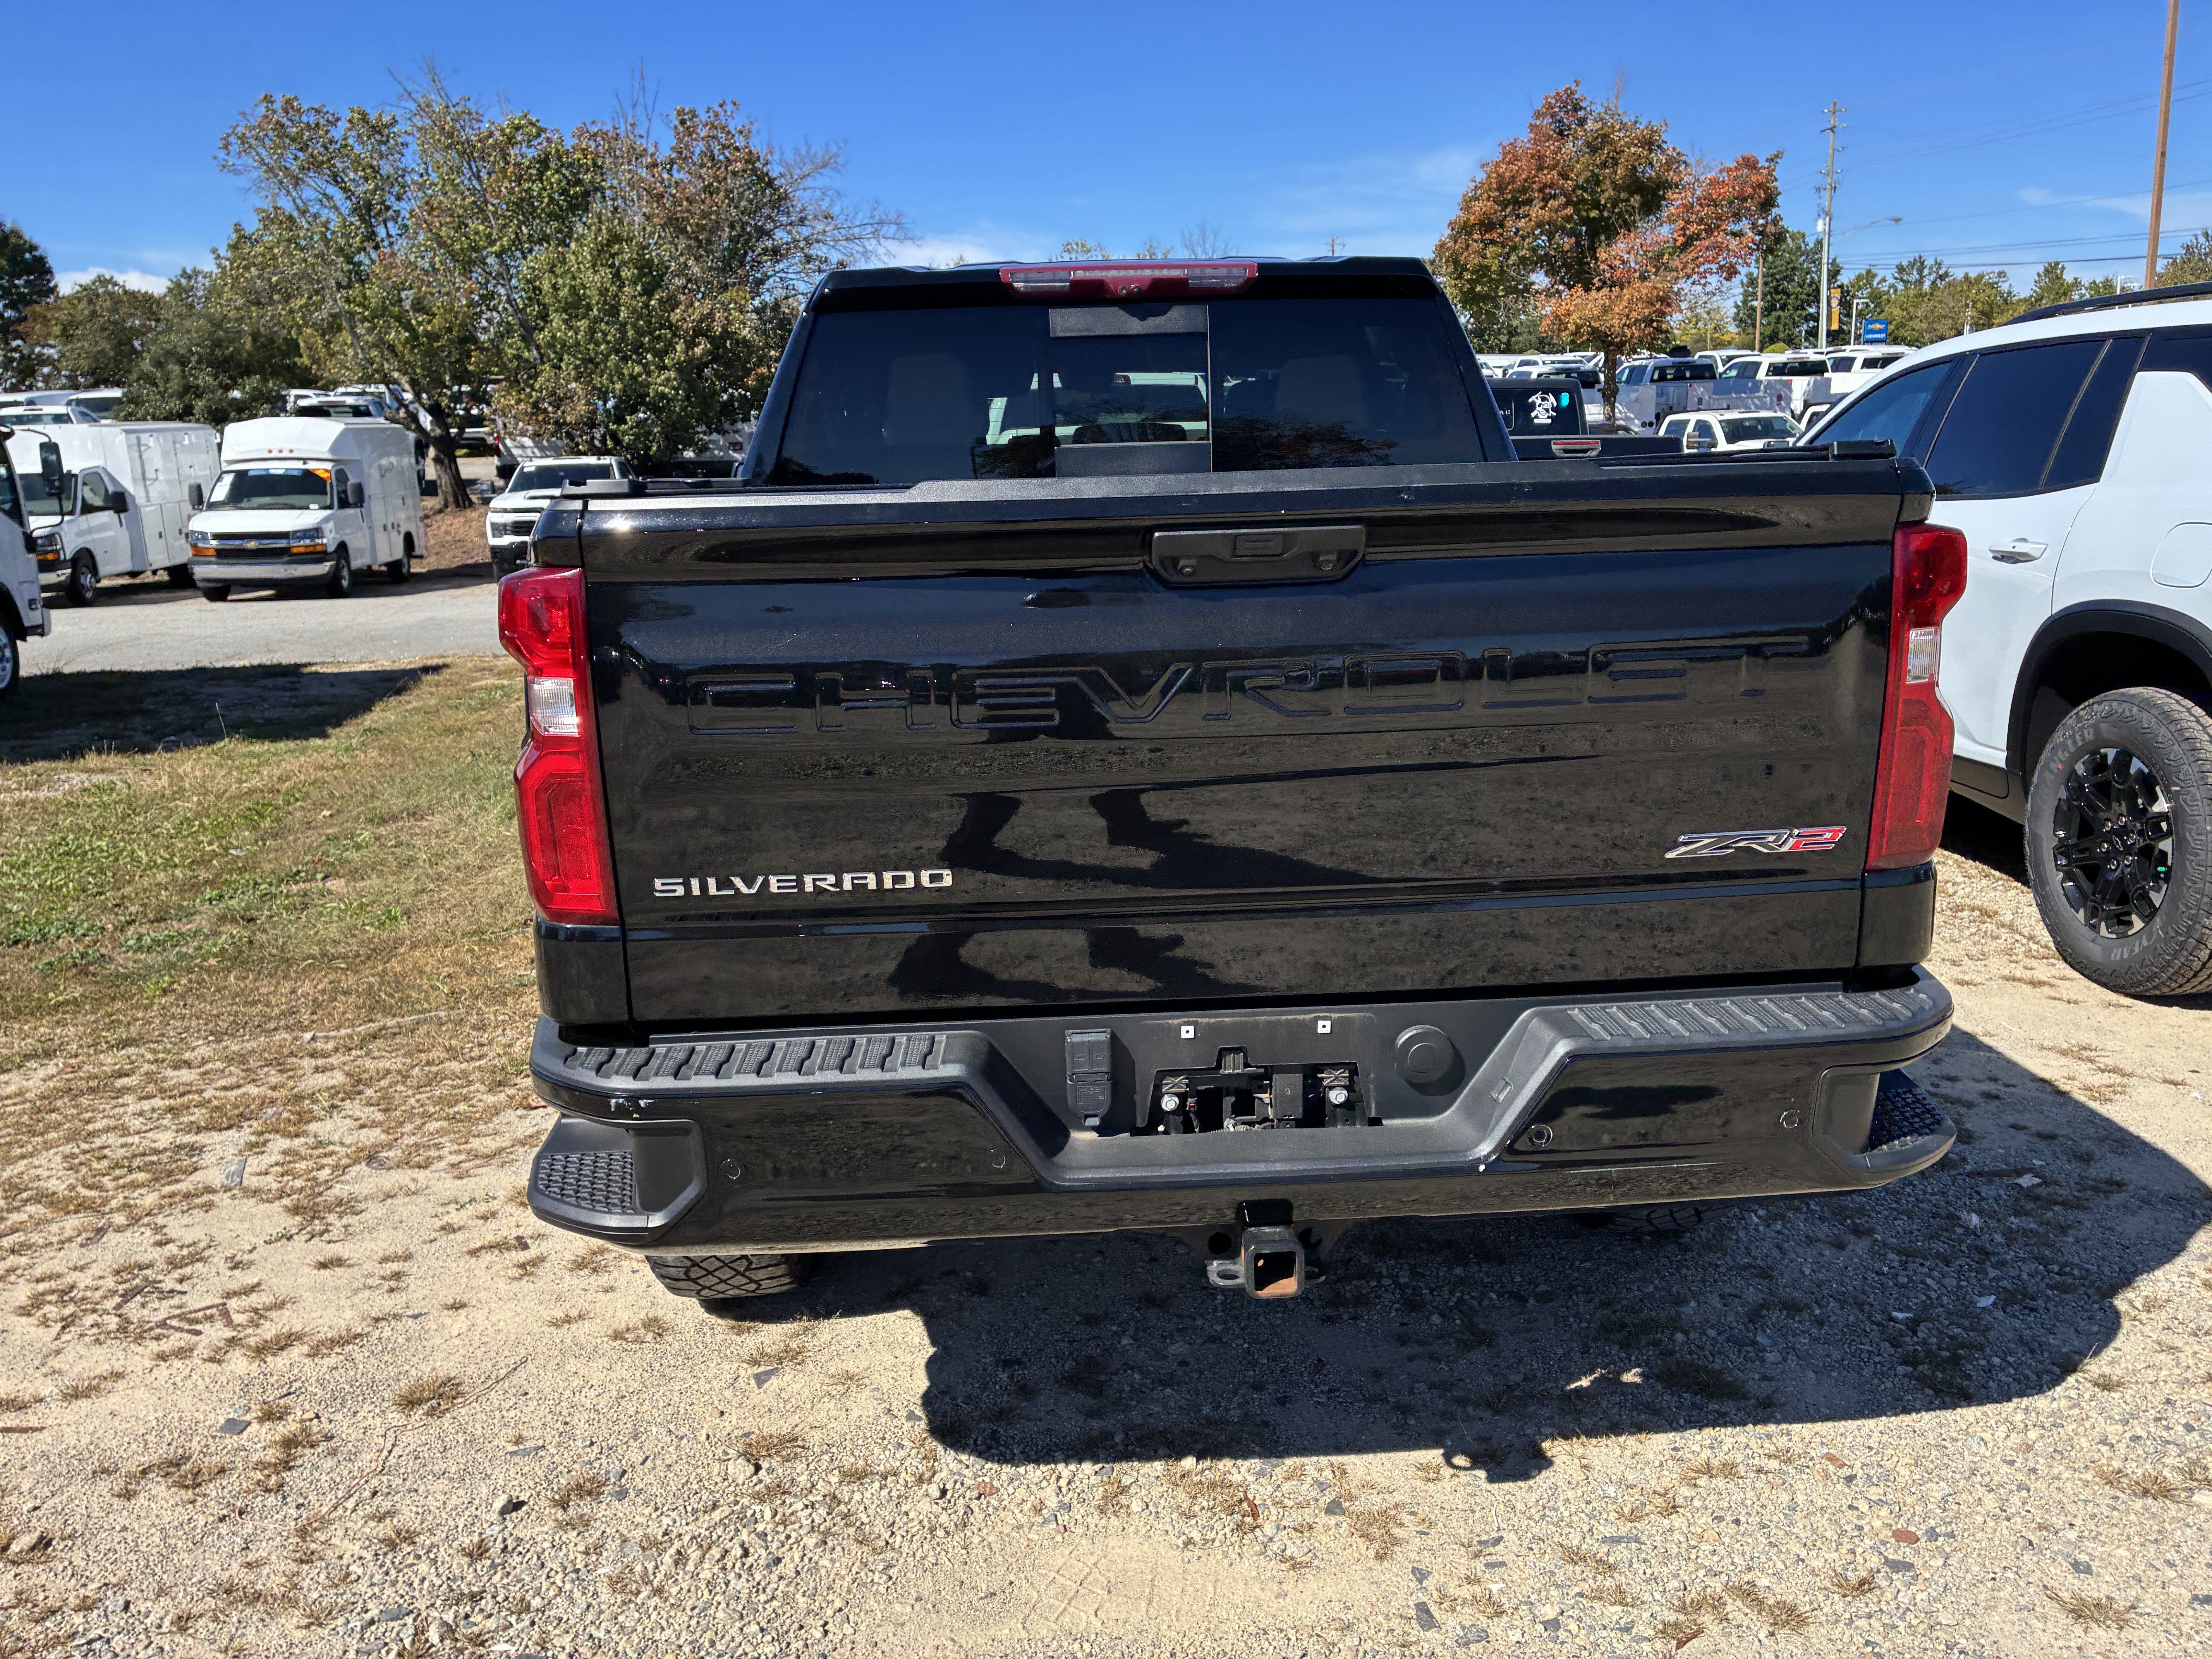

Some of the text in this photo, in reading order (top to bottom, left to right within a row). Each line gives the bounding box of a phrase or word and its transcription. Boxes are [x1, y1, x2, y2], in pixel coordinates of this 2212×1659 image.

[686, 635, 1809, 736] CHEVROLET
[1664, 825, 1847, 859] ZR2
[653, 868, 953, 897] SILVERADO
